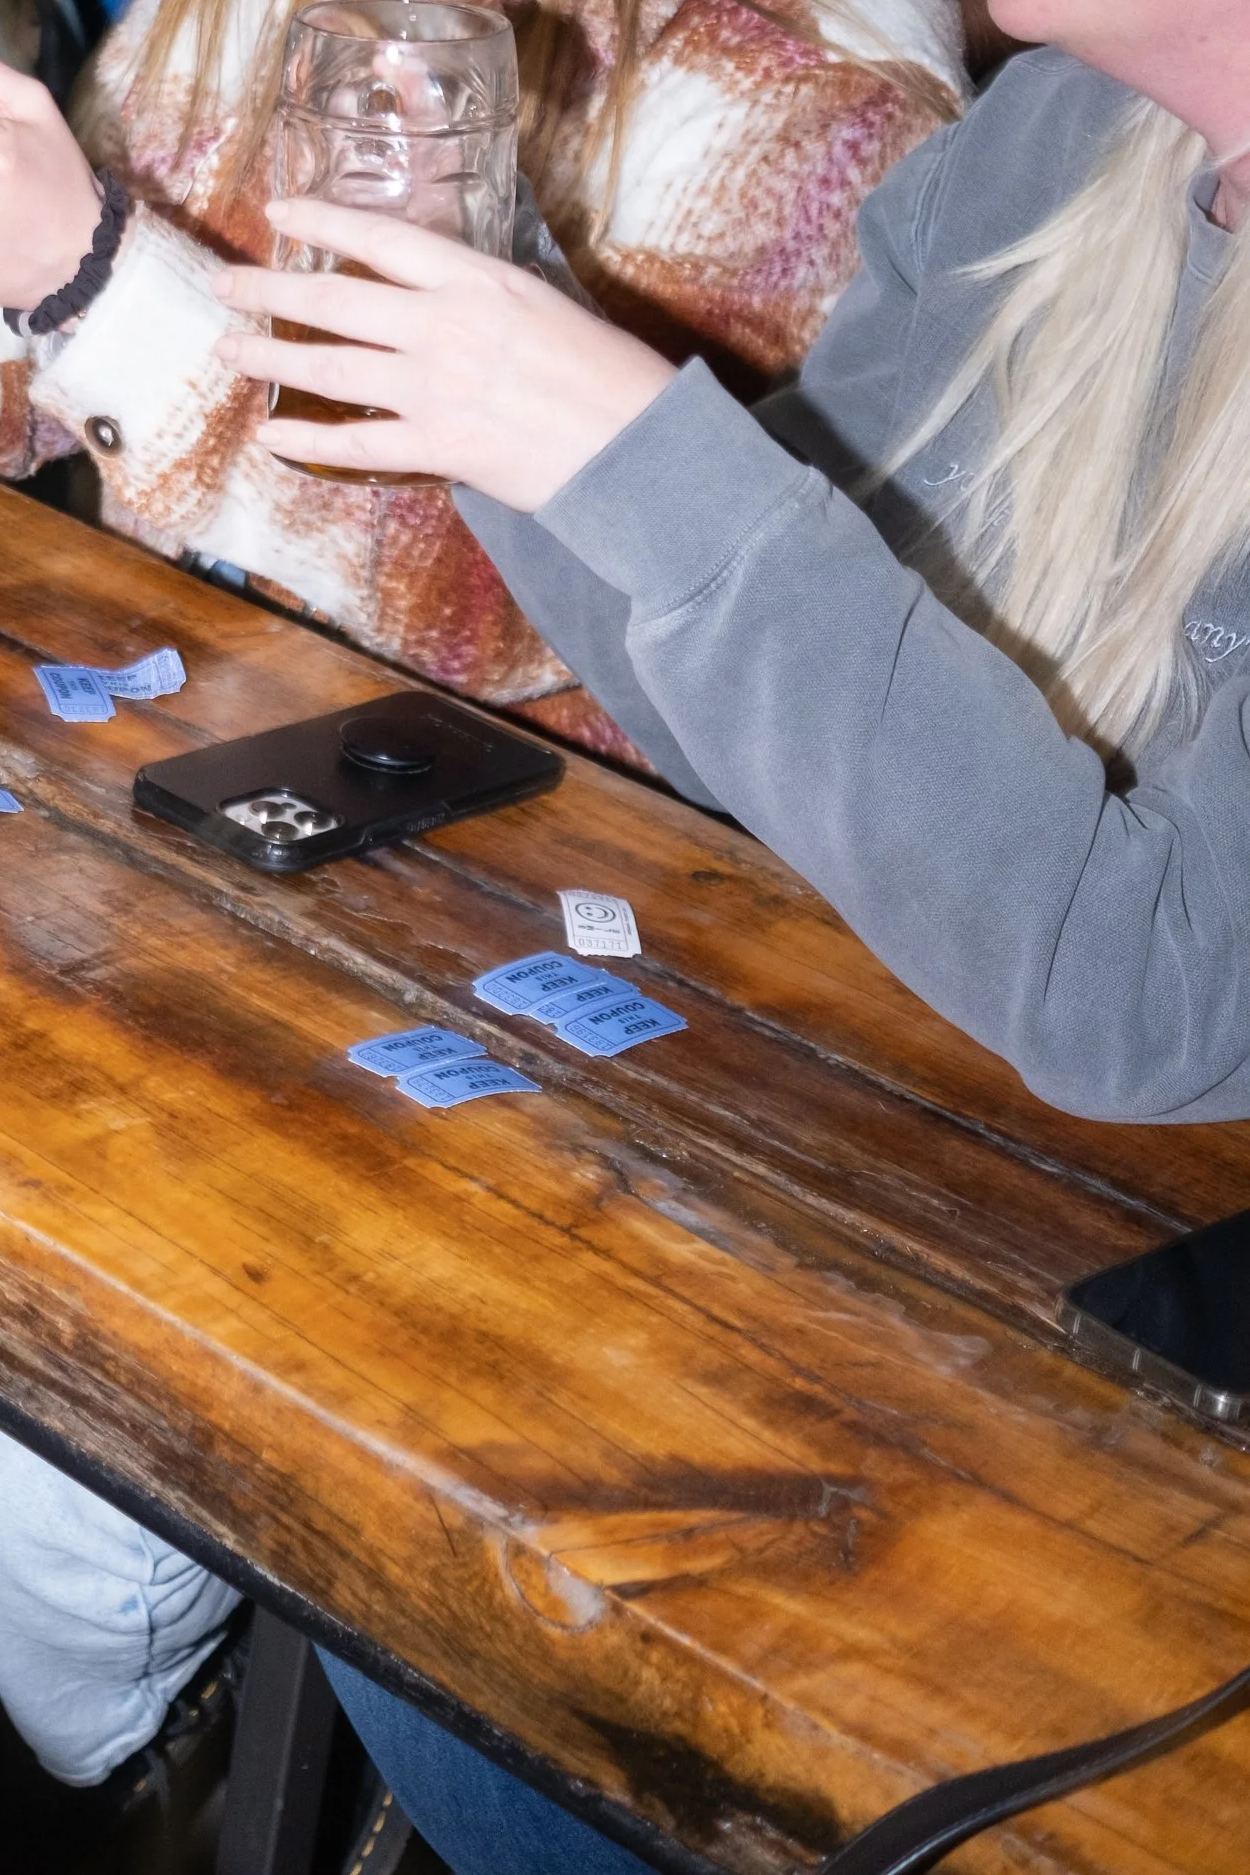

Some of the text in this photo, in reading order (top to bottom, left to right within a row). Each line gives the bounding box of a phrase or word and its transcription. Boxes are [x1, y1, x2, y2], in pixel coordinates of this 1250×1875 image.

[77, 674, 96, 695] KEEP
[505, 960, 563, 984] COUPON
[541, 975, 579, 992] KEEP
[576, 986, 614, 1002] KEEP
[587, 1001, 646, 1025] COUPON
[624, 1018, 662, 1035] KEEP
[382, 1034, 443, 1052] COUPON
[418, 1047, 458, 1060] KEEP
[433, 1065, 501, 1081] COUPON
[468, 1078, 512, 1090] KEEP
